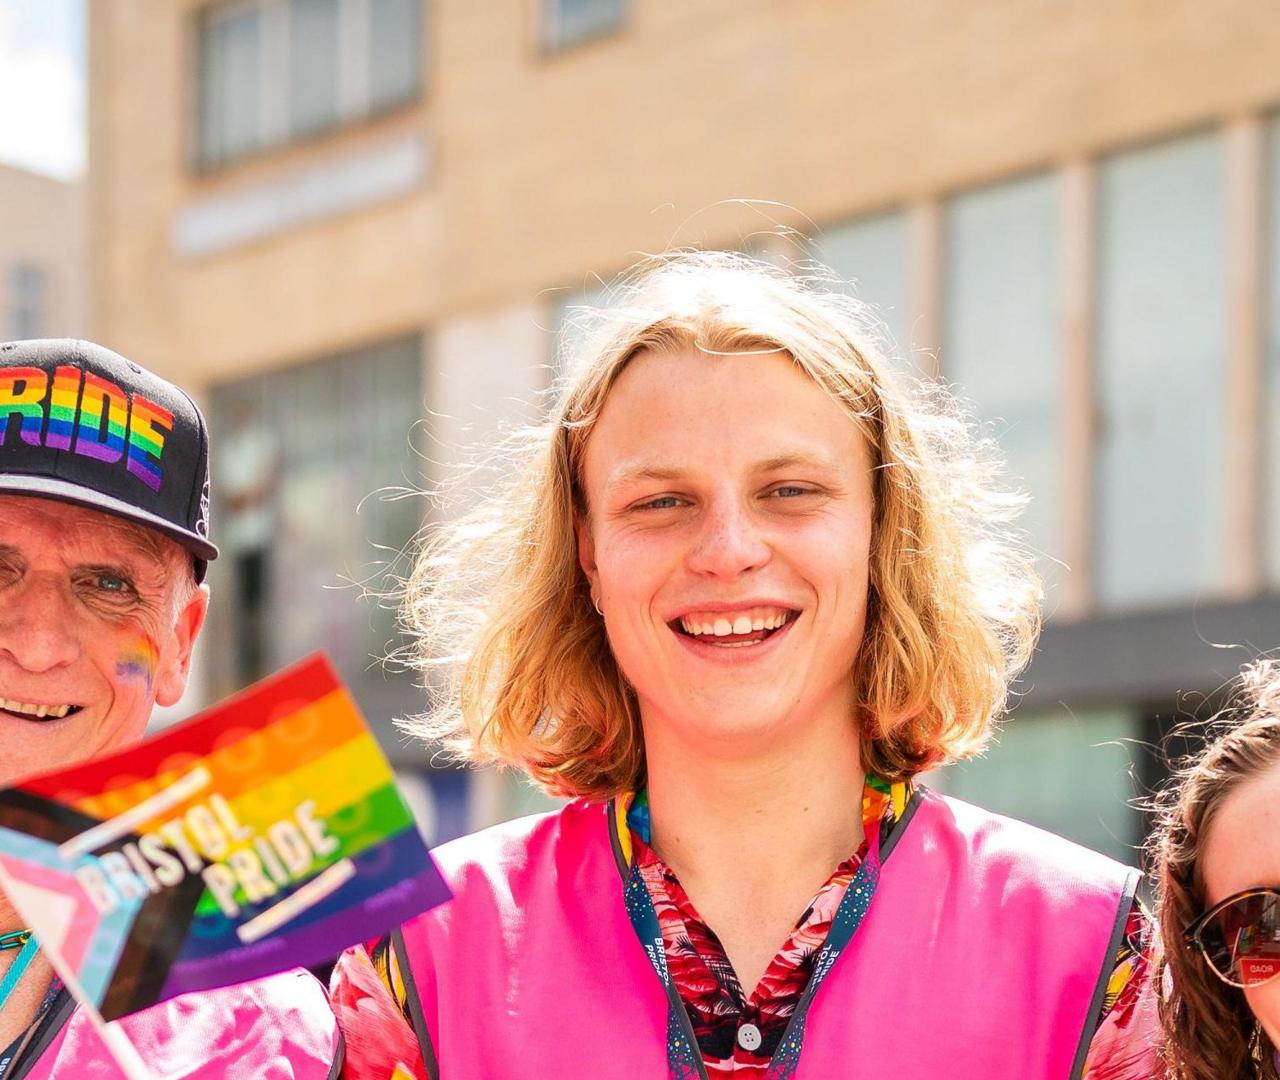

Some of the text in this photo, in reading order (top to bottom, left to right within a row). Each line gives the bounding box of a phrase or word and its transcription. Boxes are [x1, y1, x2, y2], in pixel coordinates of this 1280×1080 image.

[76, 794, 252, 914] BRISTOL
[202, 800, 339, 917] PRIDE
[810, 944, 832, 993] ISTOL
